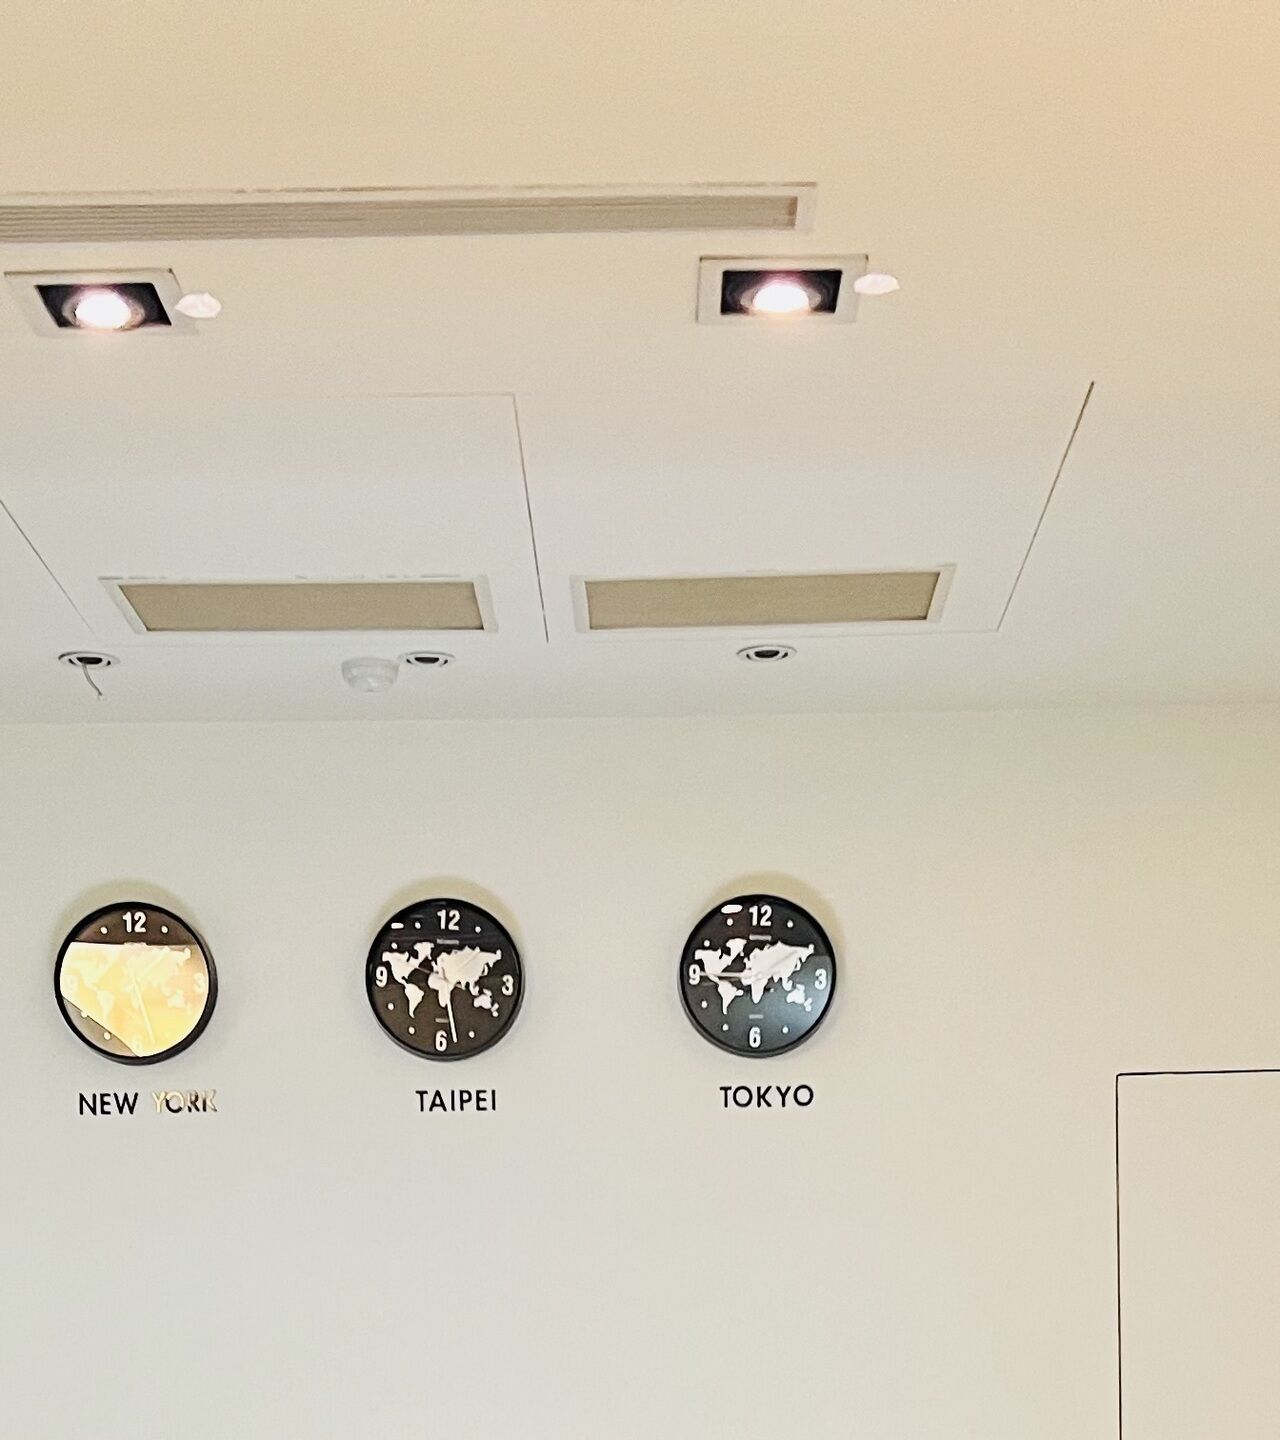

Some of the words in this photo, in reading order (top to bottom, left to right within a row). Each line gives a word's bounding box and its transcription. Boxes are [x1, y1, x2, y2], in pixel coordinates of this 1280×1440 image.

[122, 911, 147, 933] 12
[437, 909, 461, 931] 12
[749, 905, 772, 927] 12
[375, 966, 388, 987] 9
[502, 974, 515, 996] 3
[688, 964, 701, 985] 9
[815, 968, 827, 990] 3
[435, 1030, 448, 1052] 6
[748, 1026, 761, 1048] 6
[79, 1092, 138, 1116] NEW
[152, 1088, 218, 1114] YORK
[415, 1089, 497, 1112] TAIPEI
[719, 1085, 814, 1108] TOKYO
